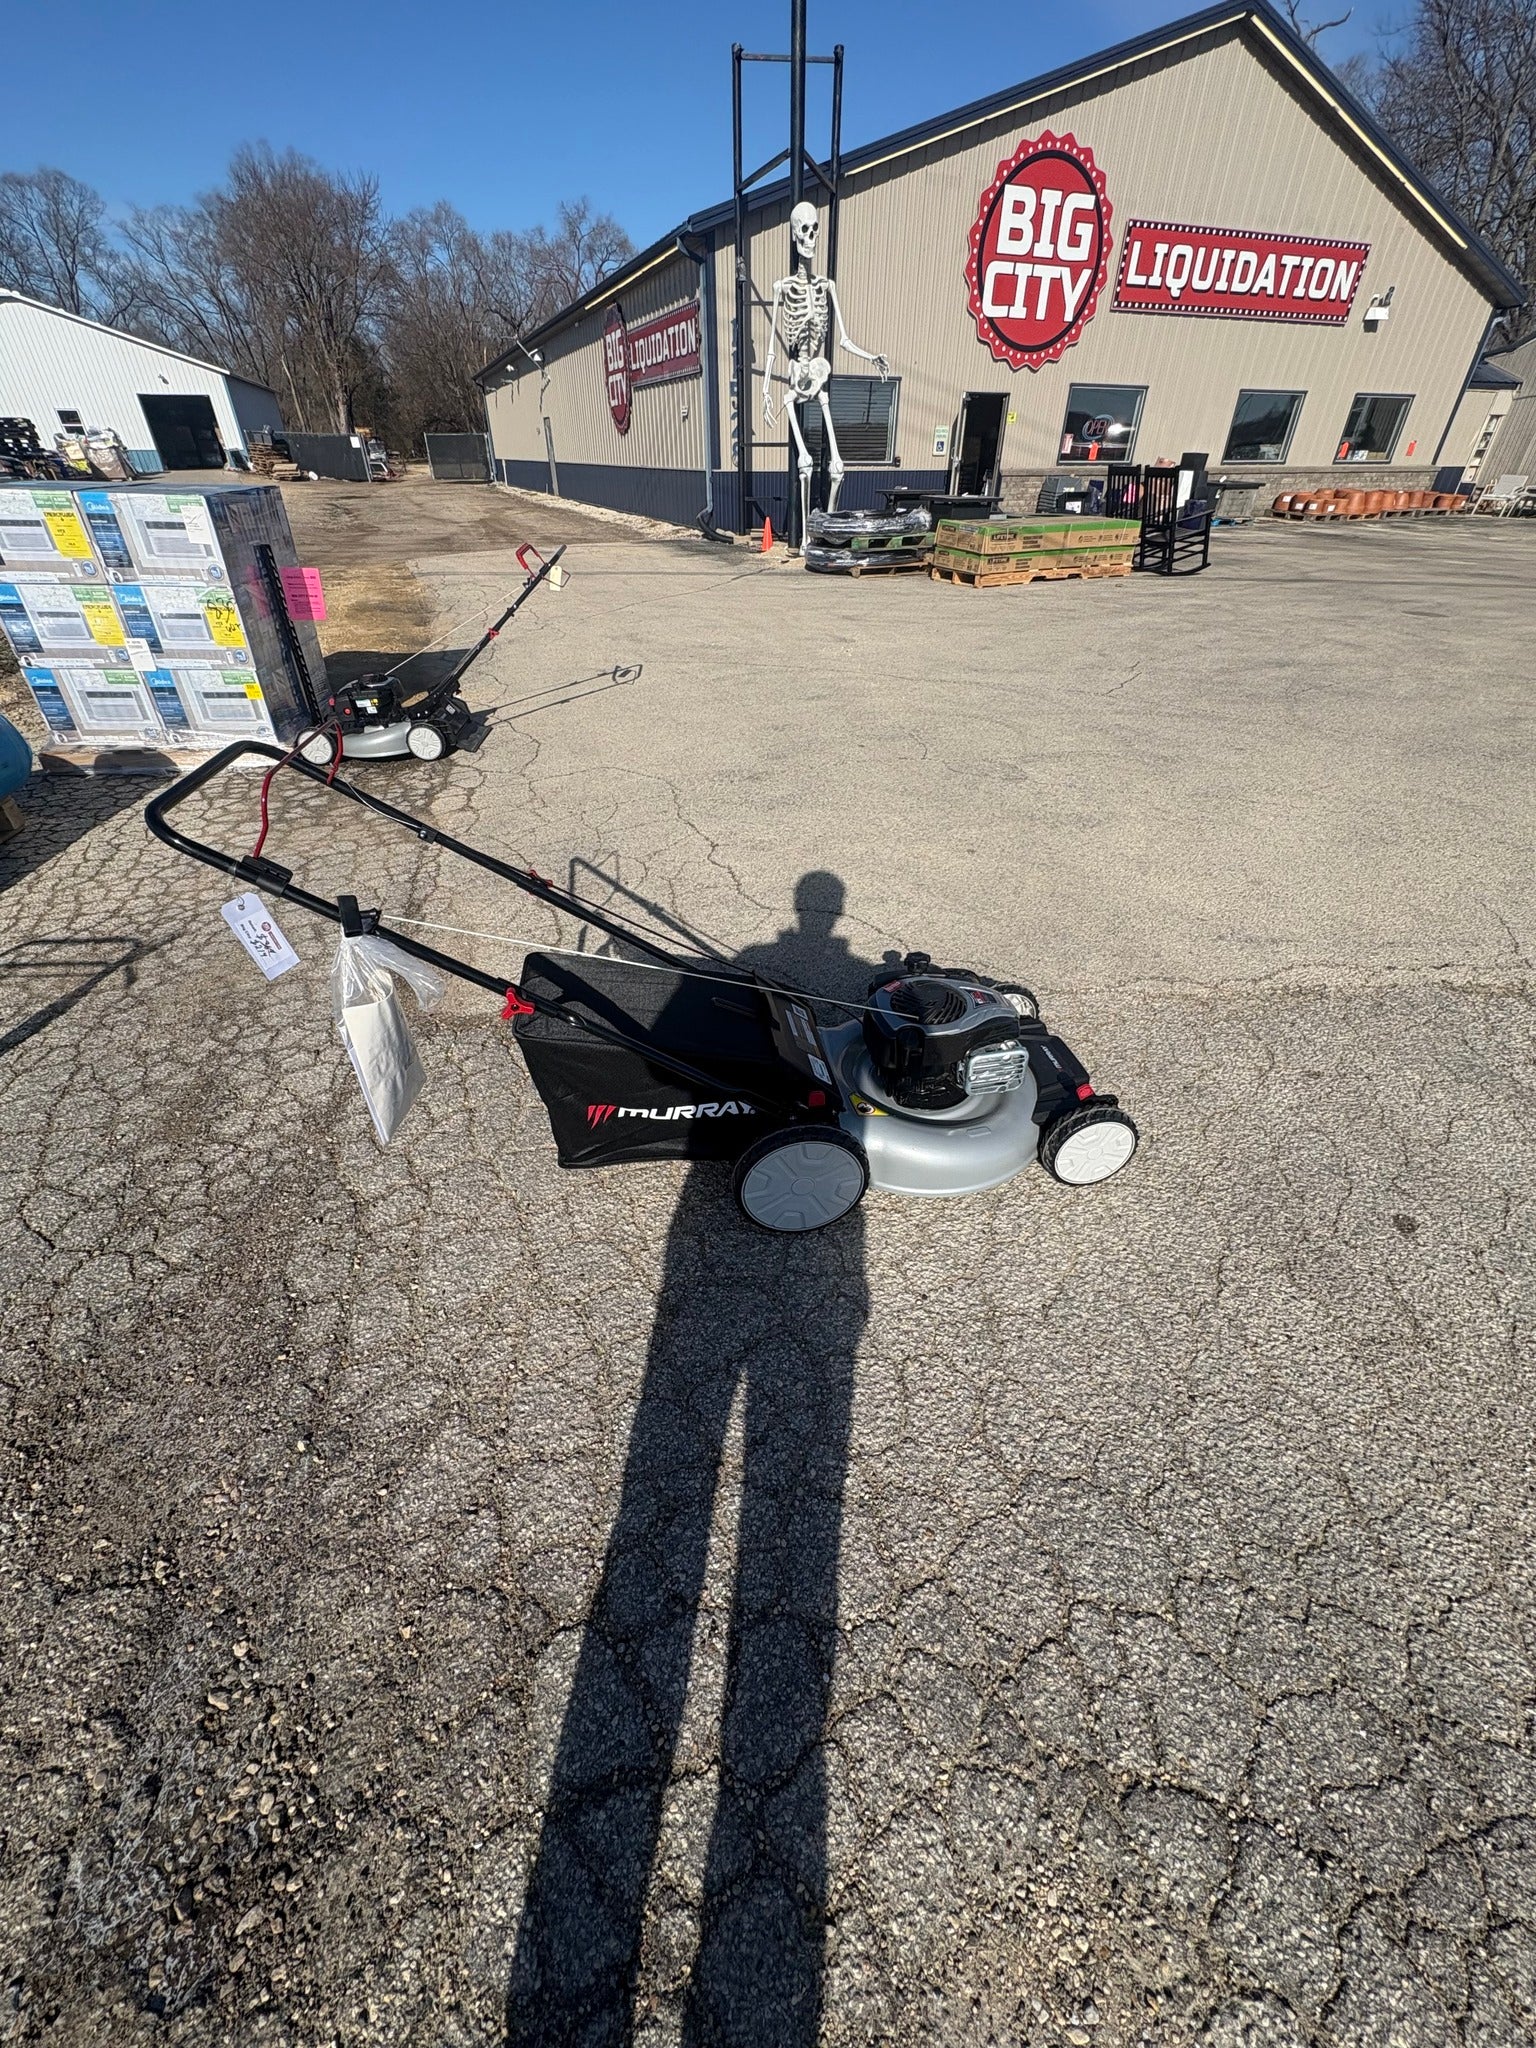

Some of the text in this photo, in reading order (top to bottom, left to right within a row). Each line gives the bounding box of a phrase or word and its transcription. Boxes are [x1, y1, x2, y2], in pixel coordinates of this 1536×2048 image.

[997, 184, 1096, 262] BIG
[982, 261, 1091, 323] CITY
[1126, 241, 1358, 301] LIQUIDATION
[605, 329, 624, 372] BIG
[630, 318, 696, 373] LIQUIDATION
[608, 371, 627, 407] CITY
[617, 1101, 752, 1120] MURRAY
